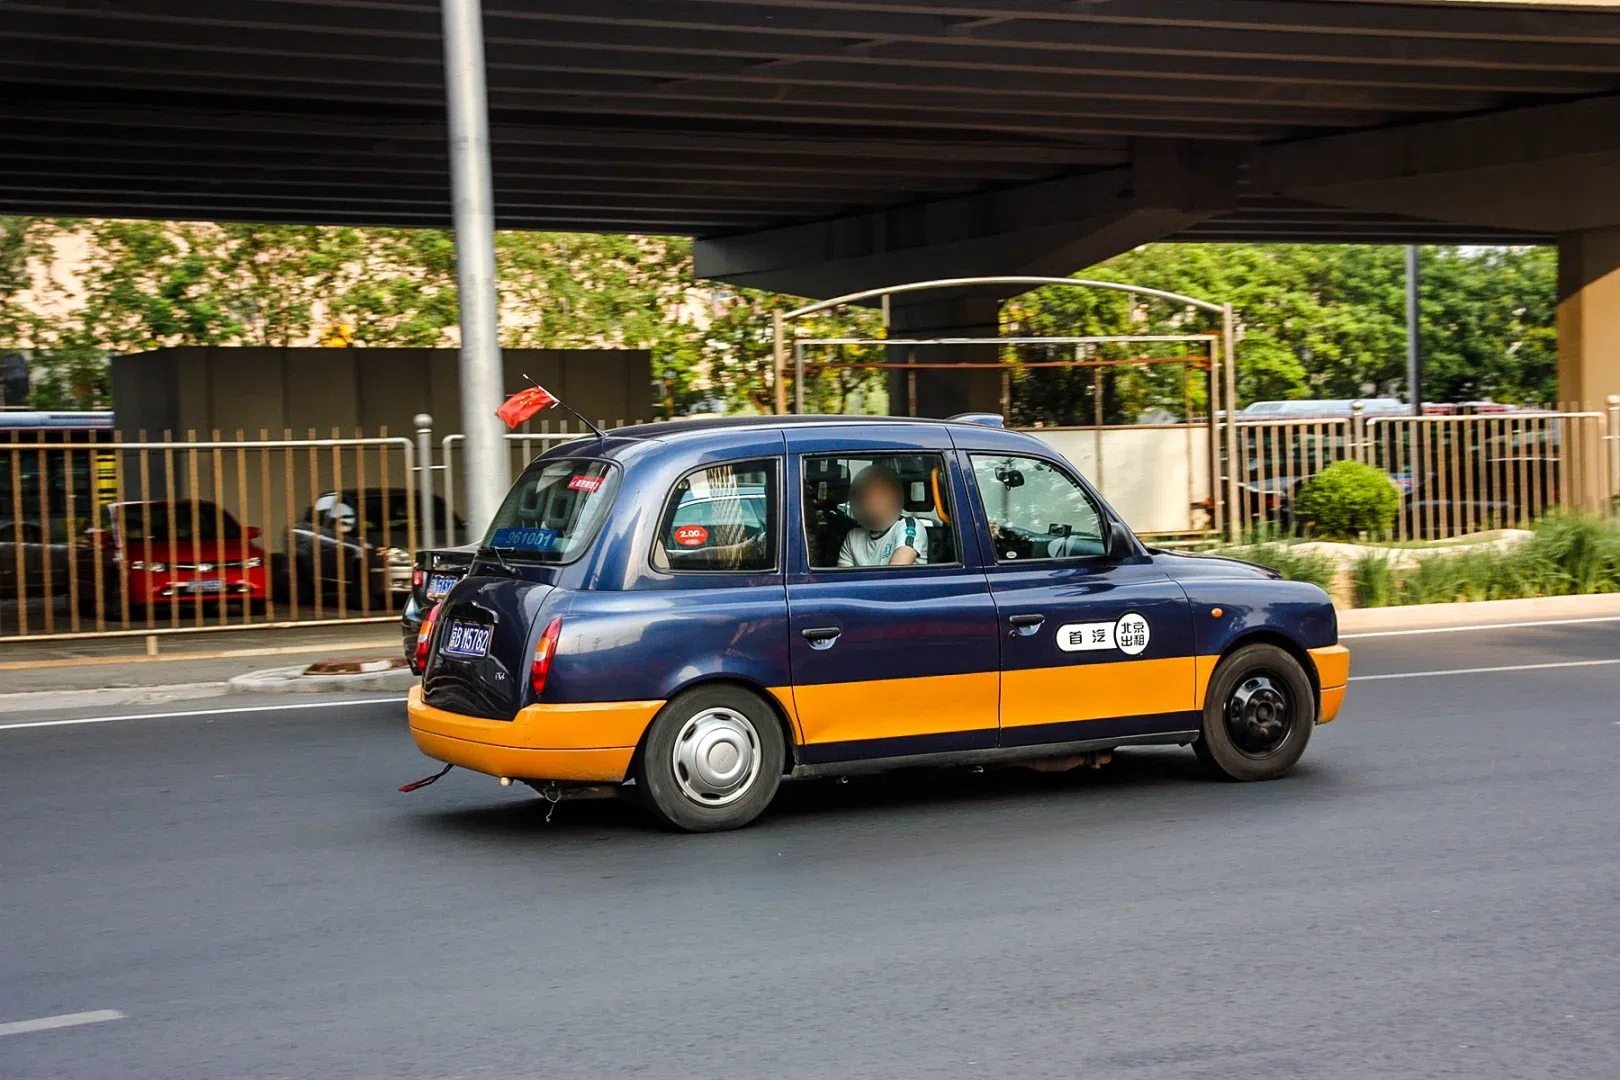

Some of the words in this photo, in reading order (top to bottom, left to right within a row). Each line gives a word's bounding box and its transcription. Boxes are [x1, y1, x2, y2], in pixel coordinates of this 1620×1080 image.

[680, 530, 700, 538] 2.00
[1121, 622, 1144, 634] 北京
[1121, 634, 1144, 646] 出租
